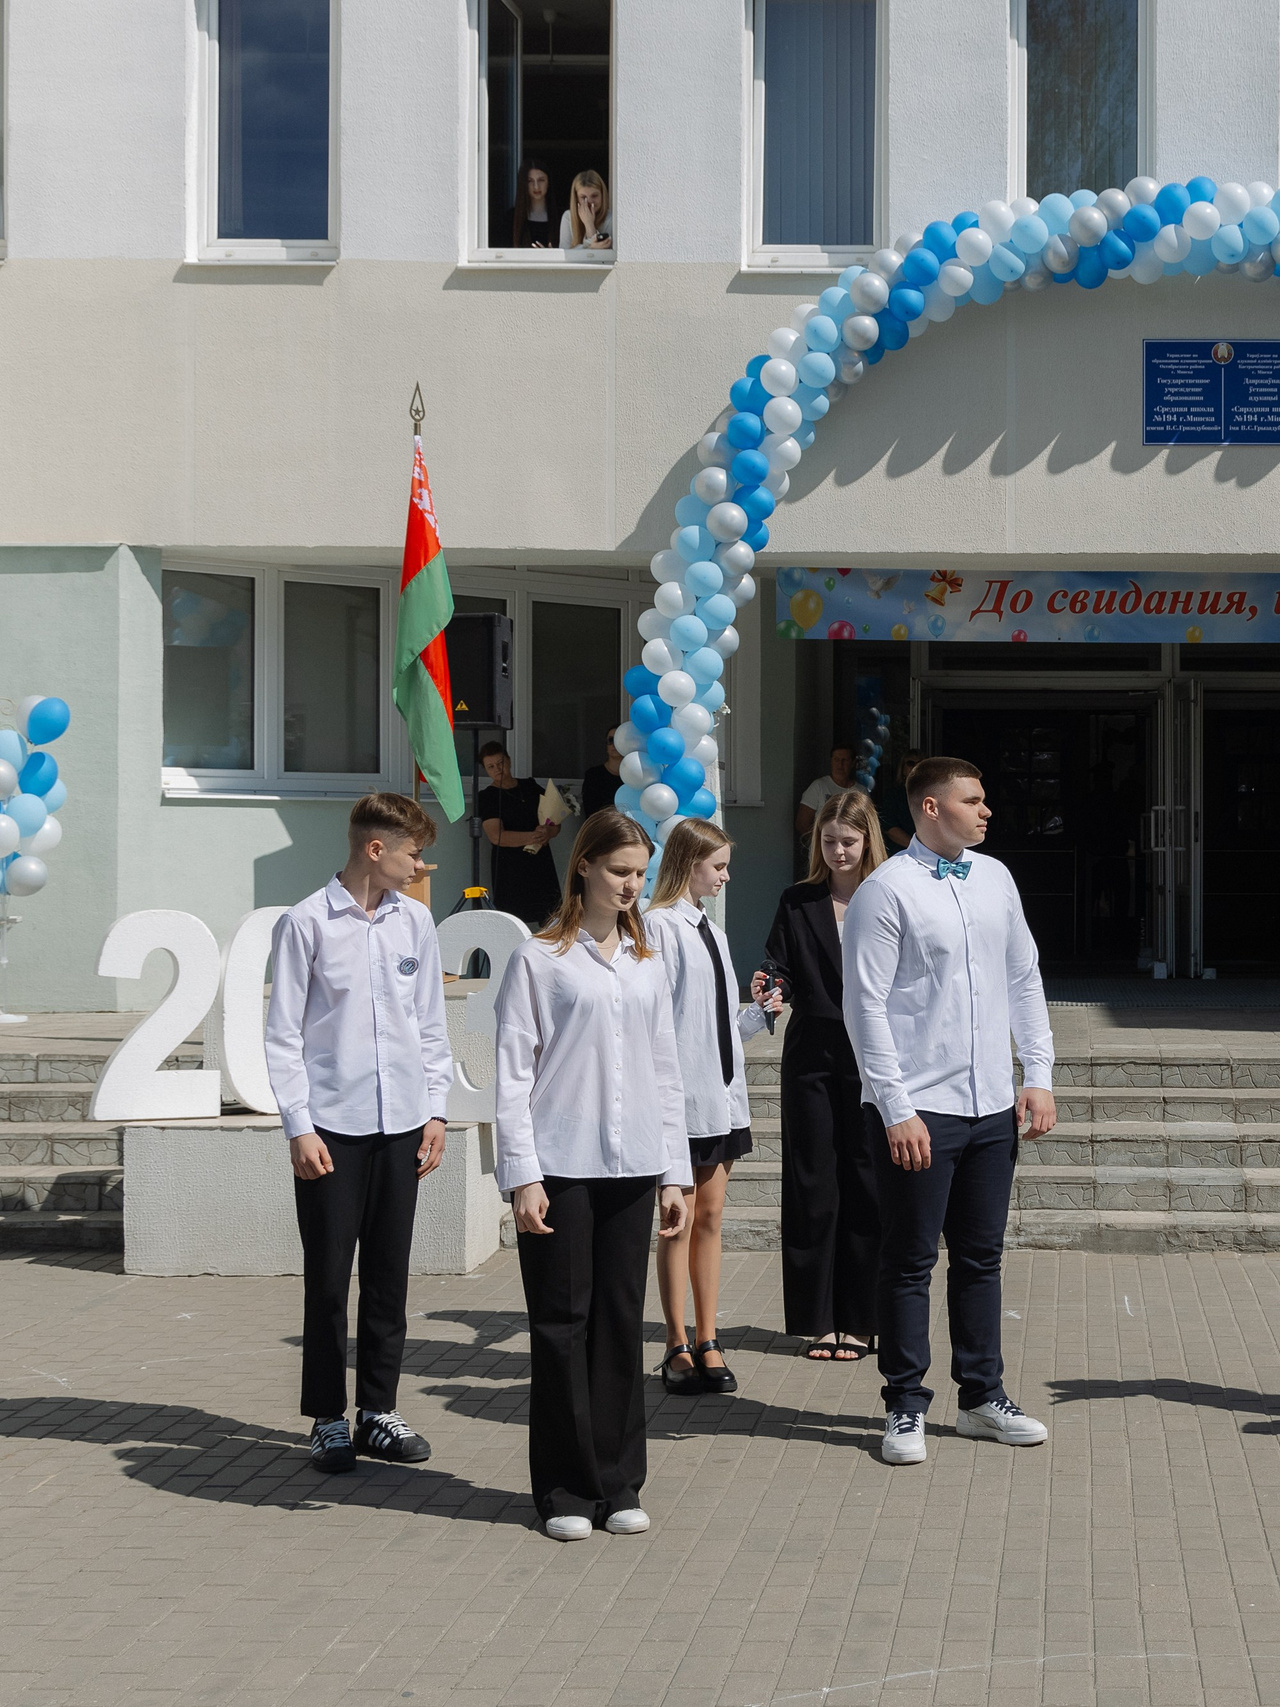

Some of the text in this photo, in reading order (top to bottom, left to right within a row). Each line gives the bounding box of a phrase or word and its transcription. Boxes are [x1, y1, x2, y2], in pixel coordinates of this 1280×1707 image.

[1157, 377, 1211, 385] Государственное
[1163, 394, 1204, 402] образования
[1152, 414, 1177, 422] №194
[1233, 414, 1258, 422] №194
[968, 579, 1034, 622] До
[1046, 579, 1259, 622] свидания,
